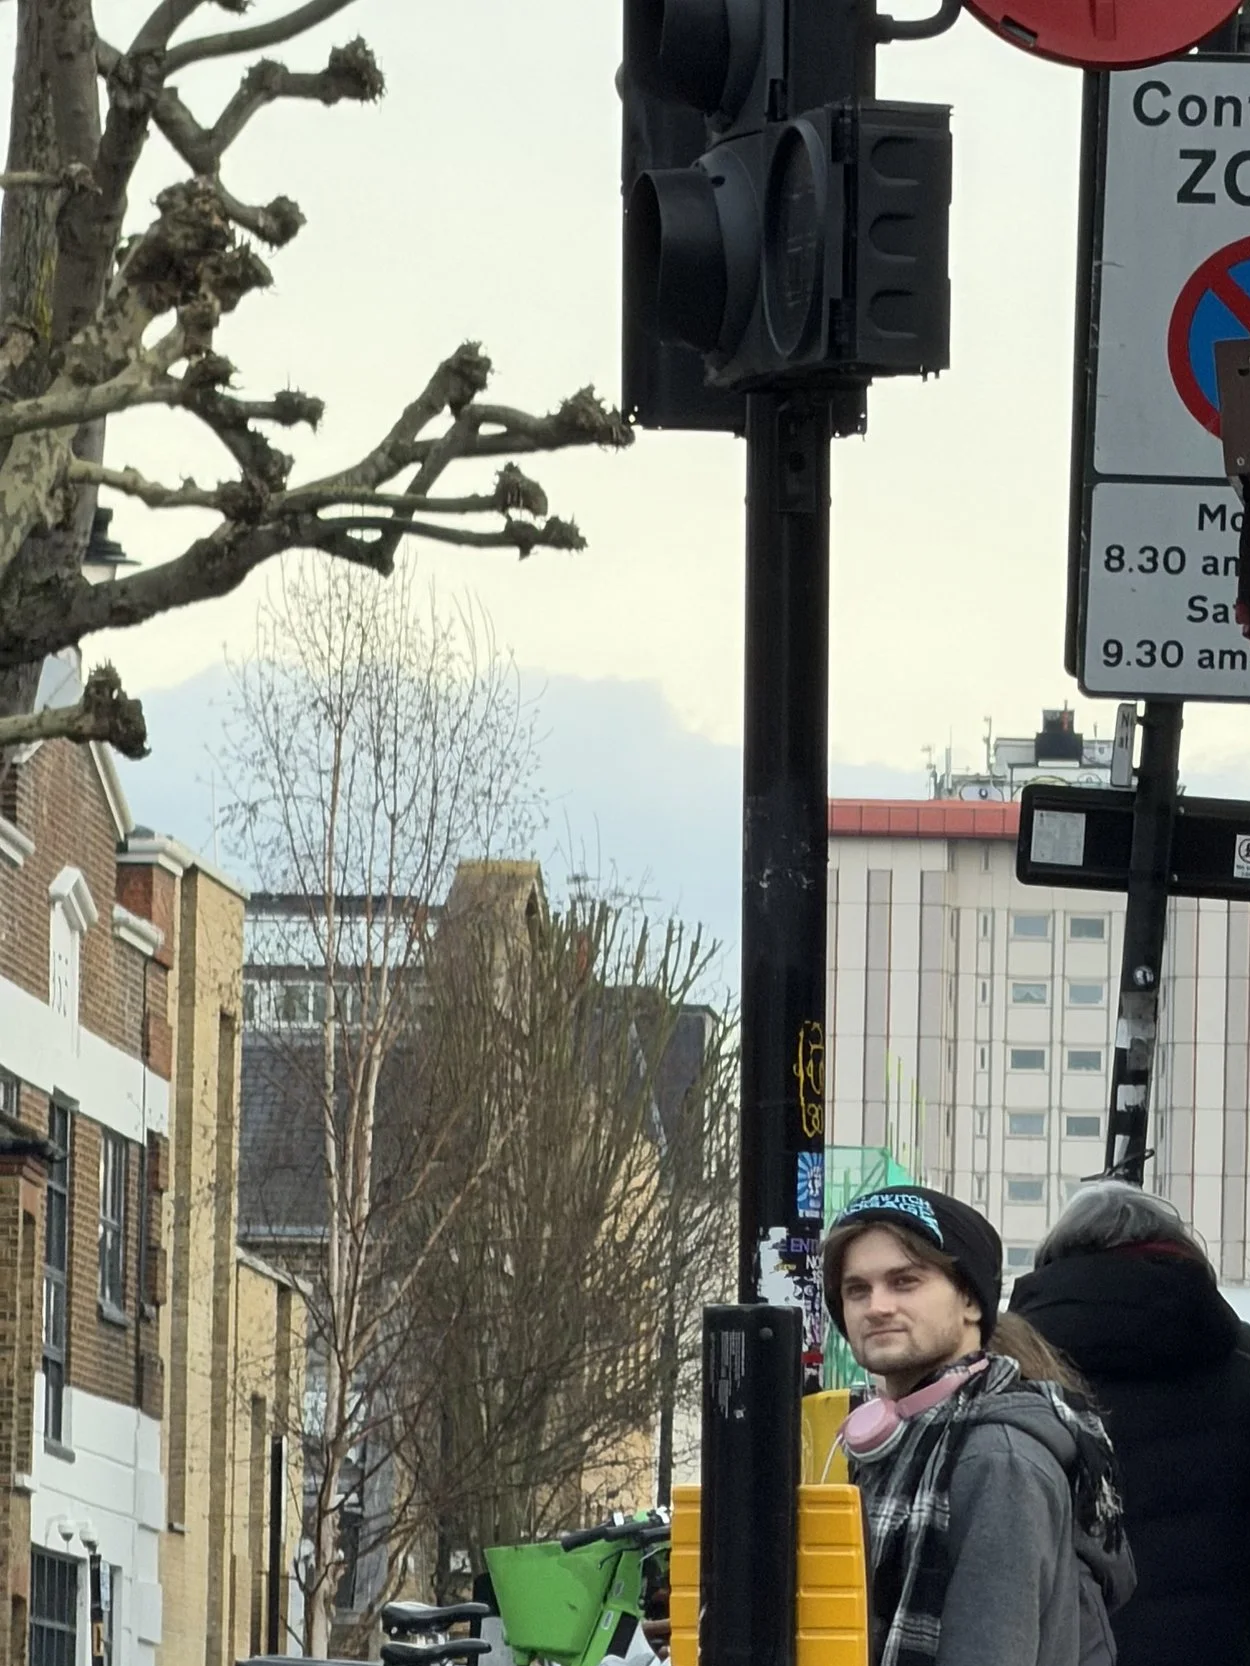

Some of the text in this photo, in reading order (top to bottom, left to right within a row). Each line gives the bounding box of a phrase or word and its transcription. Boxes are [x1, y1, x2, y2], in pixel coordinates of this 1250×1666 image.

[1103, 545, 1187, 575] 8.30
[1101, 639, 1185, 669] 9.30
[1197, 649, 1248, 671] am
